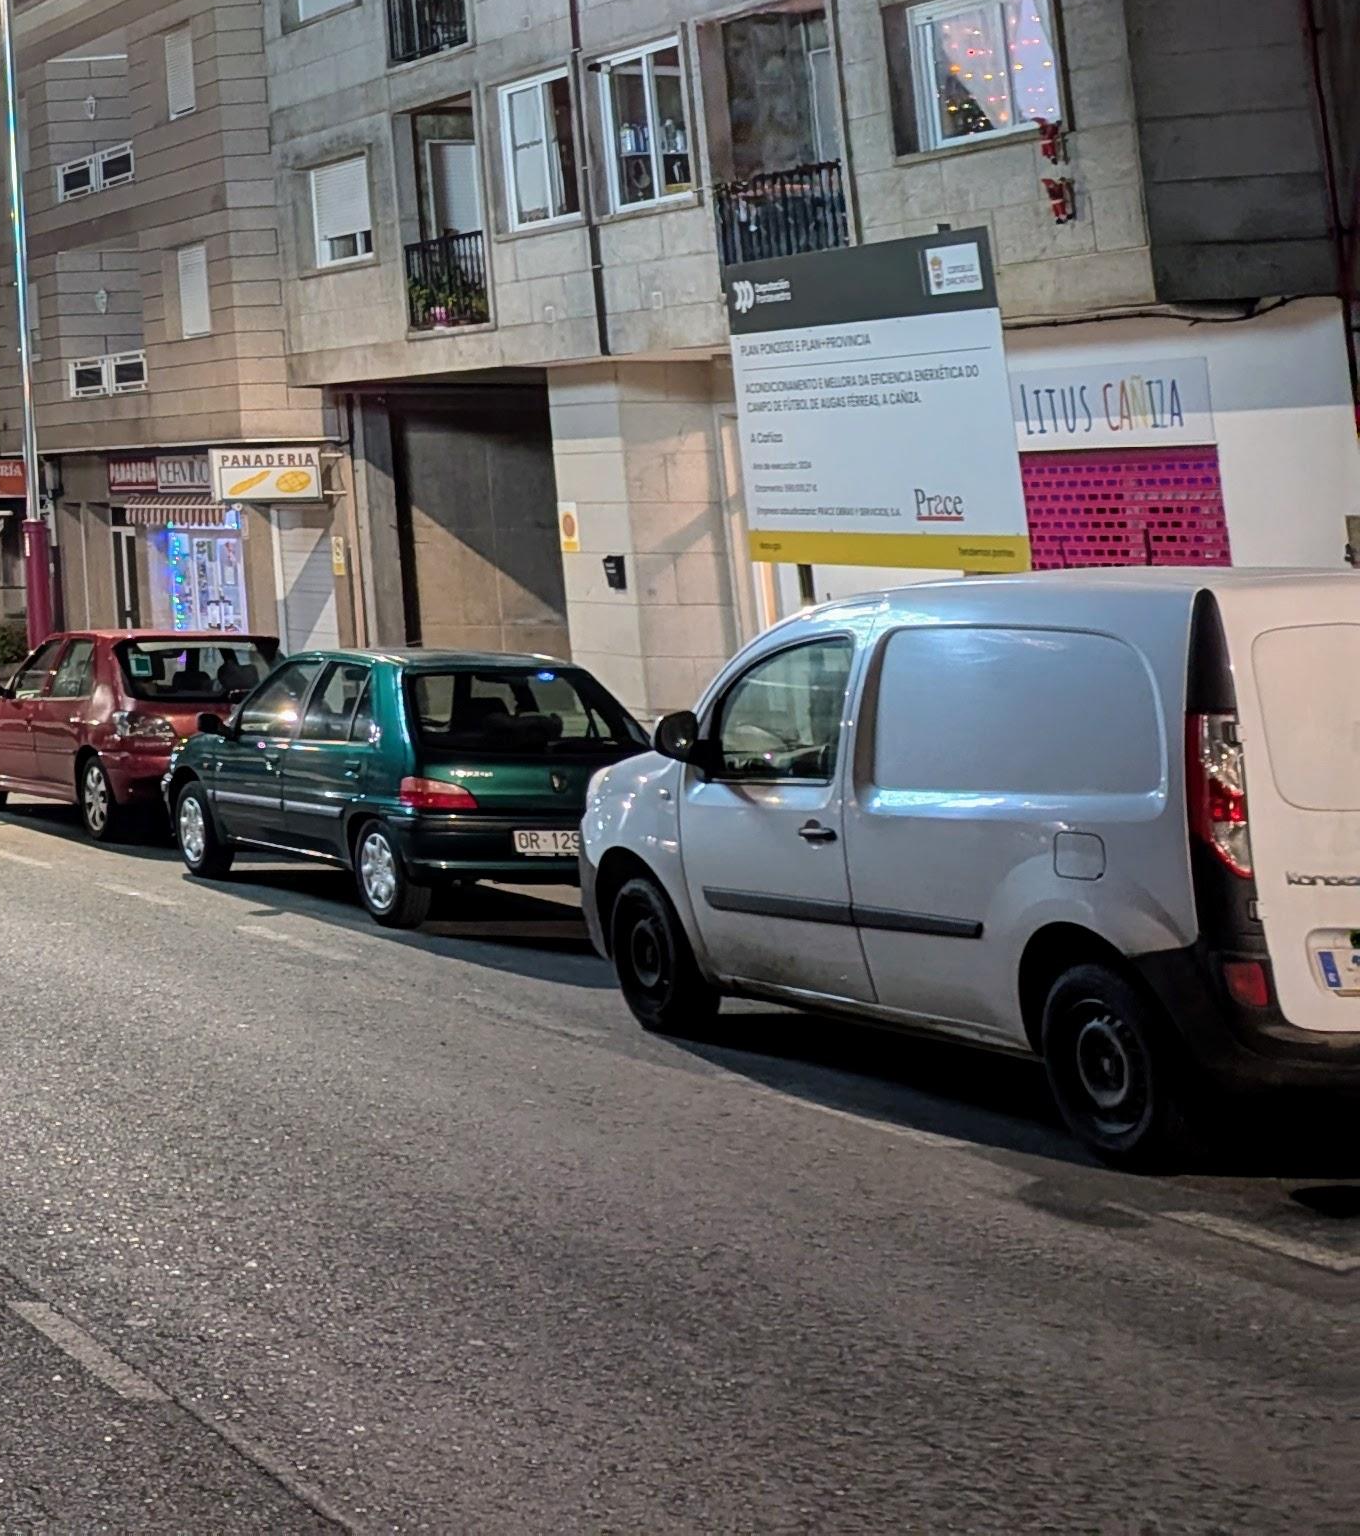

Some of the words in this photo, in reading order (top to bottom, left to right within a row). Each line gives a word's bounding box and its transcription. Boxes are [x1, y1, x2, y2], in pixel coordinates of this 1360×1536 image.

[966, 364, 980, 378] DO
[1020, 384, 1091, 435] LITUS
[1103, 374, 1184, 431] CAÑIZA
[221, 452, 314, 466] PANADERIA
[914, 488, 963, 516] Prace
